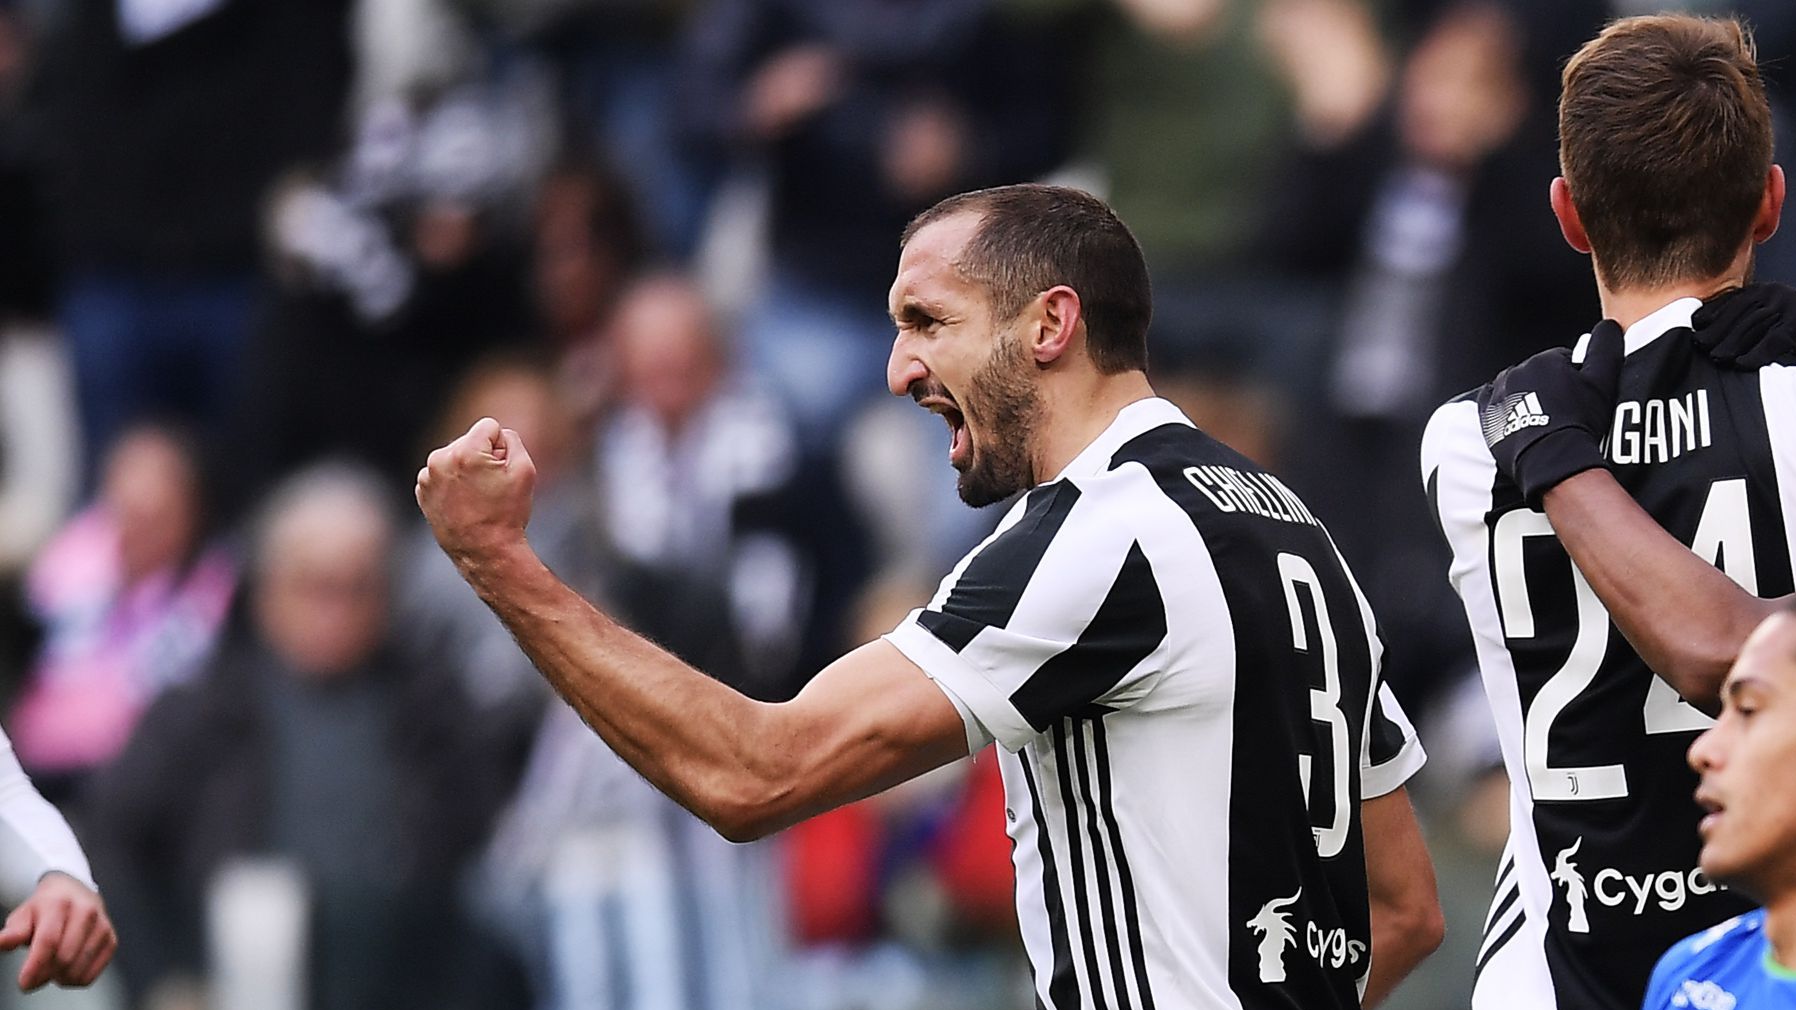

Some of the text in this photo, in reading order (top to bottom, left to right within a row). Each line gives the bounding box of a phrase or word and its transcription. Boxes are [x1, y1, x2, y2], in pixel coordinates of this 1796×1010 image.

[1503, 414, 1550, 437] adidas
[1599, 388, 1712, 465] GANI
[1277, 551, 1351, 858] 3
[1593, 867, 1728, 915] Cyga
